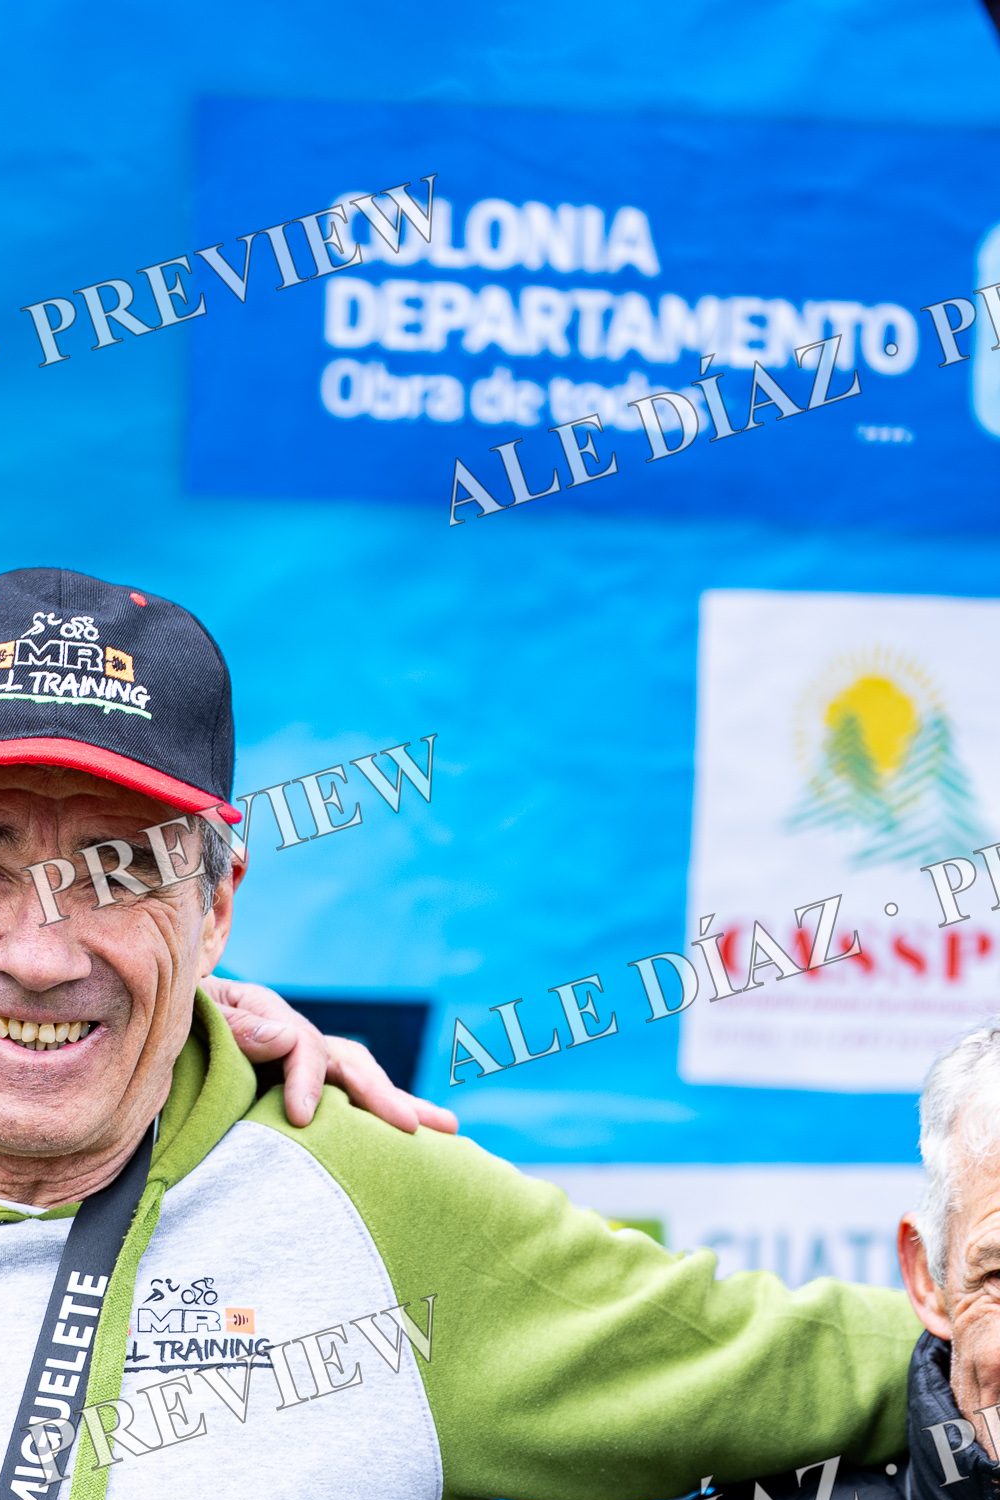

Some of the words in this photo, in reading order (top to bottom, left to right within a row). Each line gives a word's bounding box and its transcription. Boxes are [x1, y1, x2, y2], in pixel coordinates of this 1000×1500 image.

[327, 193, 661, 276] COLONIA
[325, 277, 918, 375] DEPARTAMENTO
[321, 358, 464, 421] Obra
[470, 366, 546, 427] de
[29, 671, 151, 709] TRAINING
[138, 1308, 221, 1333] MR
[153, 1338, 275, 1363] TRAINING
